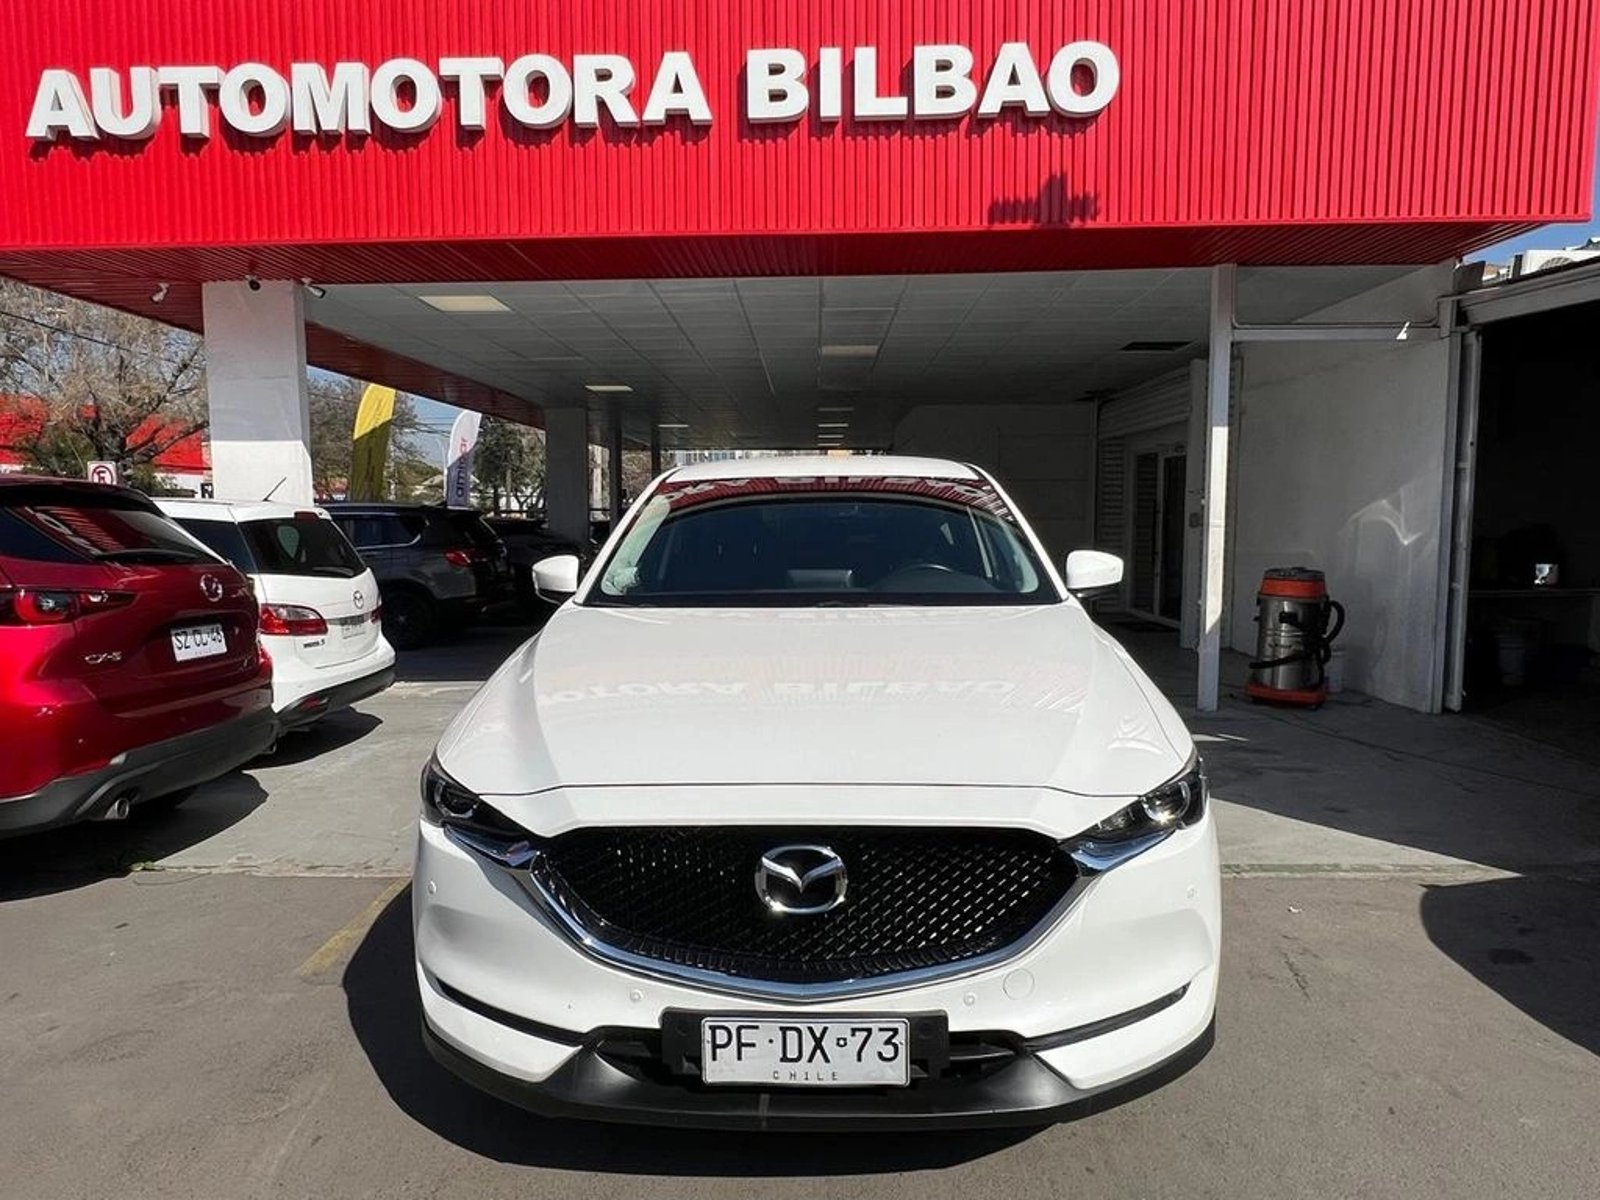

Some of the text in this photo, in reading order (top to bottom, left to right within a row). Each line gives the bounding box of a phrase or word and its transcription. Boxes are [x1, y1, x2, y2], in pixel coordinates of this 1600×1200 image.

[25, 40, 1121, 141] AUTOMOTORA BILBAO
[772, 1070, 839, 1081] CHILE
